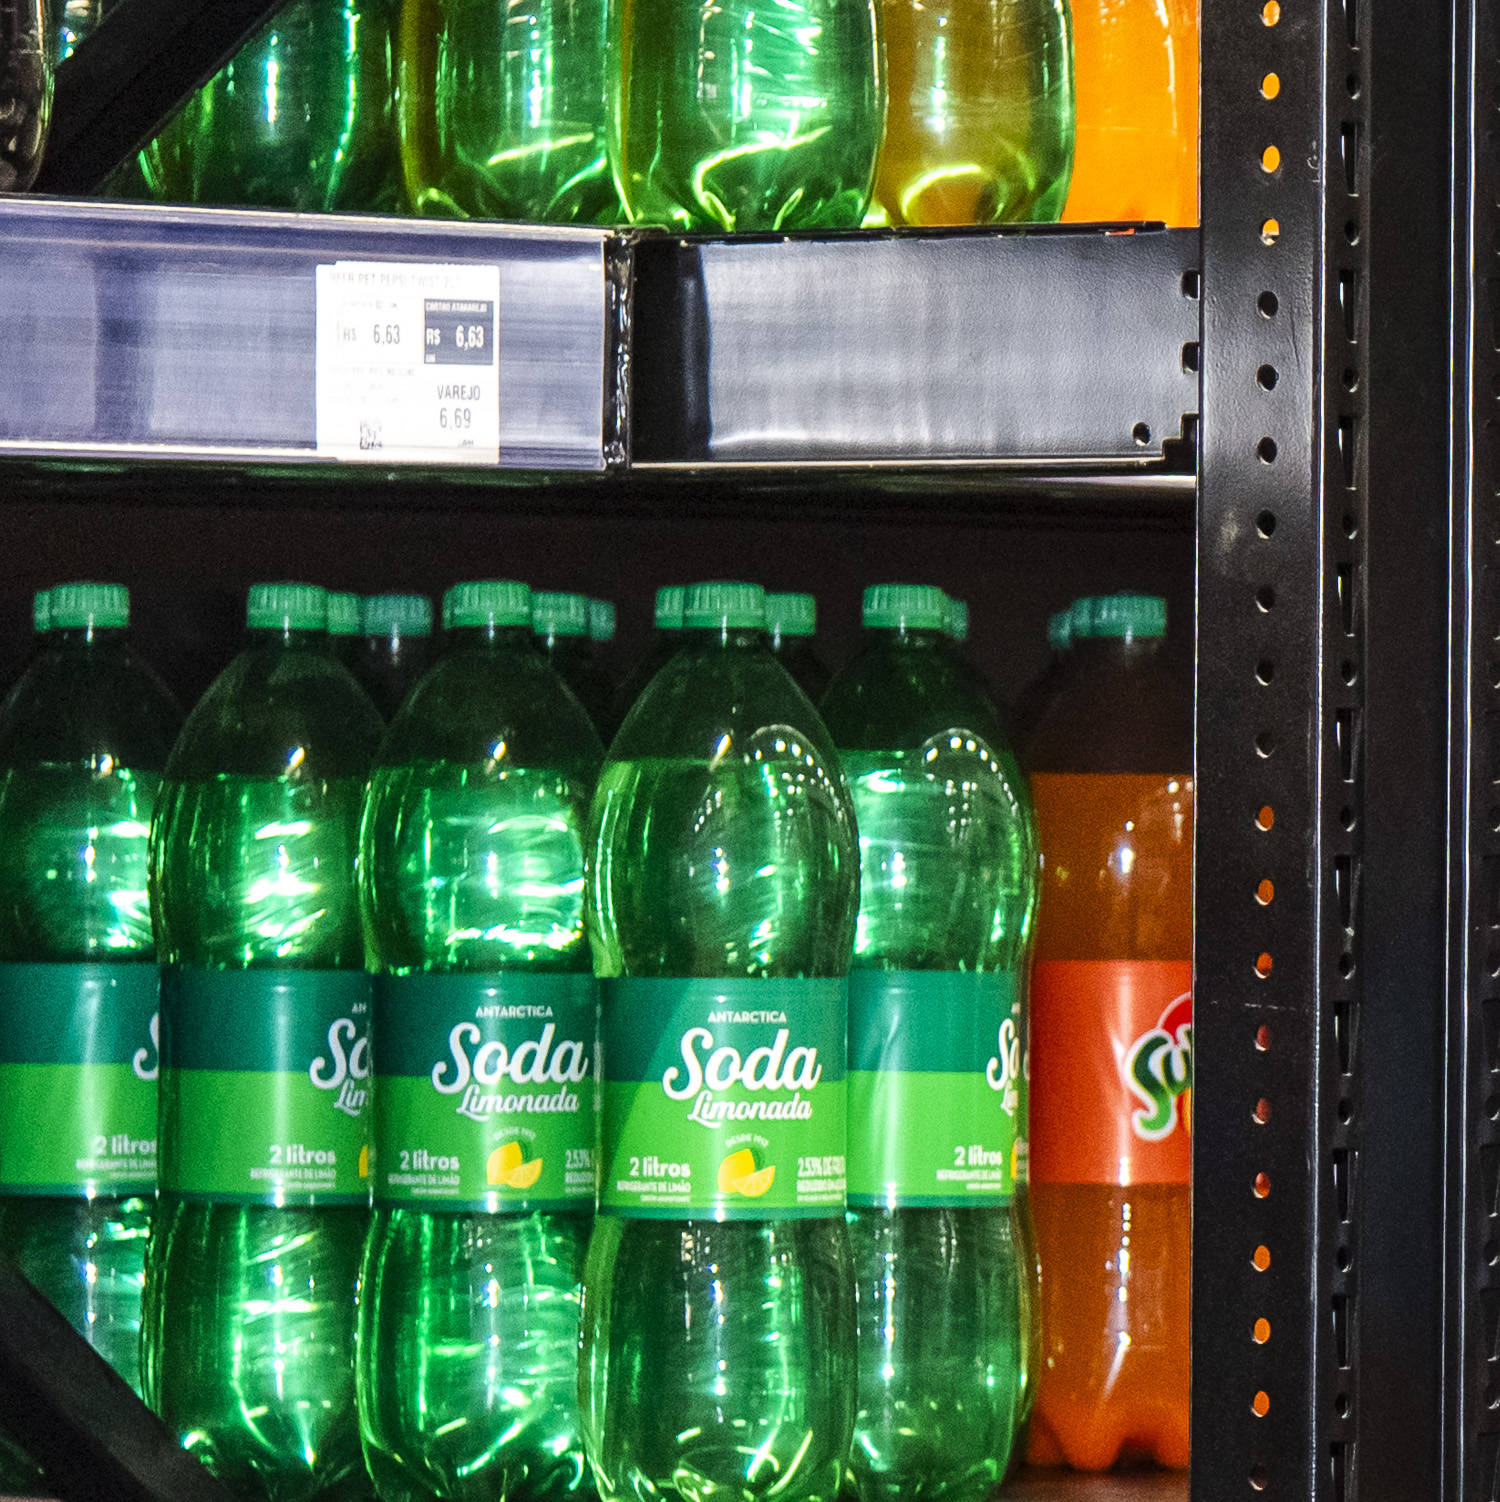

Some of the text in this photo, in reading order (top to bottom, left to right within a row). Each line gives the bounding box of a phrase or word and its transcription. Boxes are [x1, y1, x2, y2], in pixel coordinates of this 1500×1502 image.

[373, 324, 401, 345] 6,63
[426, 325, 485, 351] R$ 6,63
[437, 384, 481, 401] VAREJO
[439, 407, 472, 430] 6,69
[476, 1005, 554, 1019] ANTARCTICA
[707, 1010, 788, 1025] ANTARCTICA
[431, 1022, 590, 1094] Soda
[661, 1027, 823, 1102] Soda
[456, 1084, 580, 1121] Limonada
[687, 1091, 812, 1128] Limonada
[269, 1144, 336, 1165] 2 litros
[400, 1150, 460, 1171] 2 litros
[954, 1147, 965, 1166] 2
[630, 1156, 691, 1178] 2 litros
